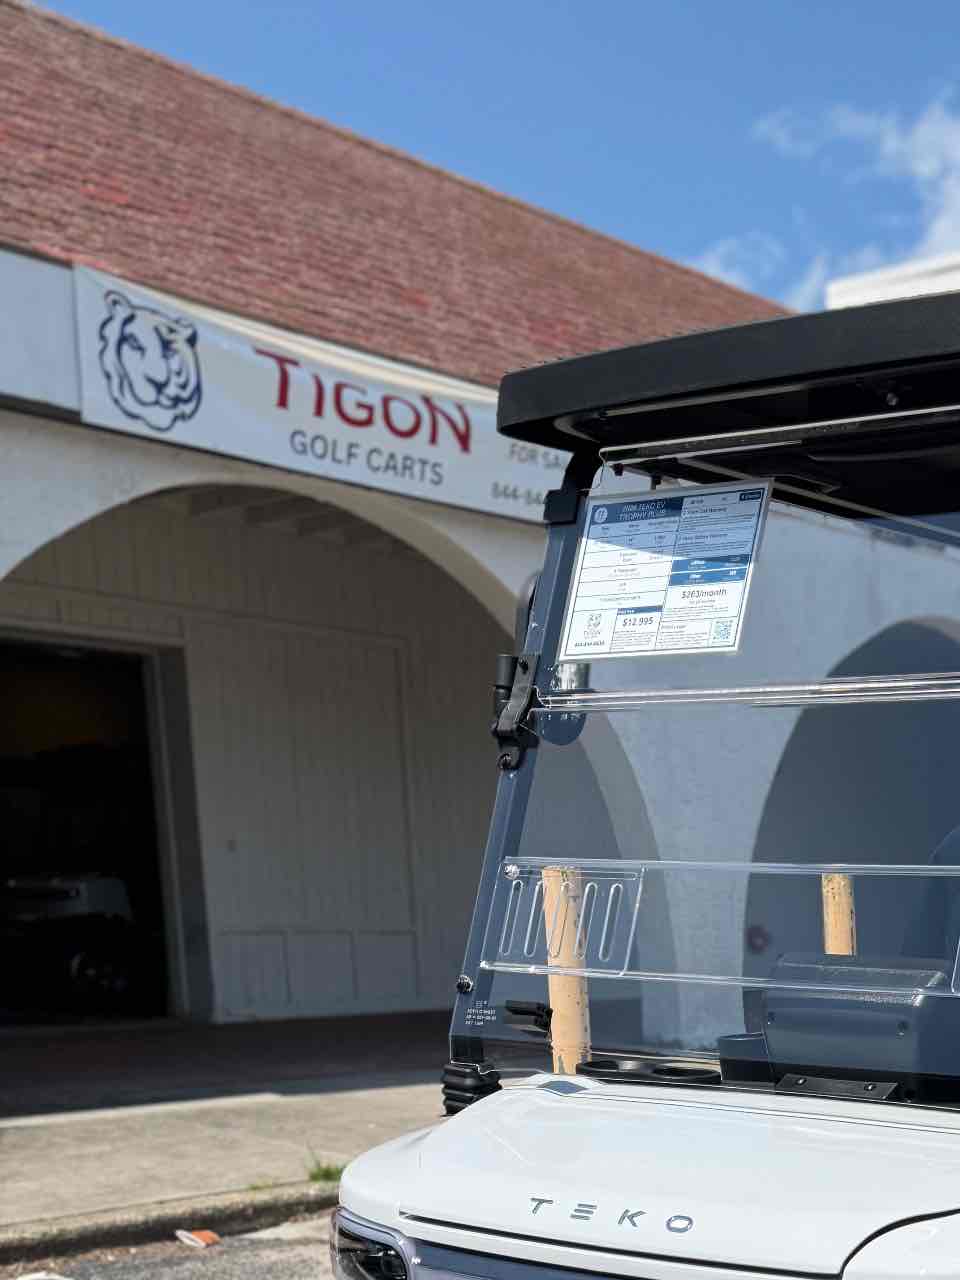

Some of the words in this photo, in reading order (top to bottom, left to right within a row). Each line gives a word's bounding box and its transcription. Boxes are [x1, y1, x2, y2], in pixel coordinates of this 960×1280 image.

[253, 346, 471, 453] TIGON
[289, 429, 361, 465] GOLF
[366, 447, 445, 486] CARTS
[508, 442, 539, 464] FOR
[530, 1197, 692, 1233] TEKO
